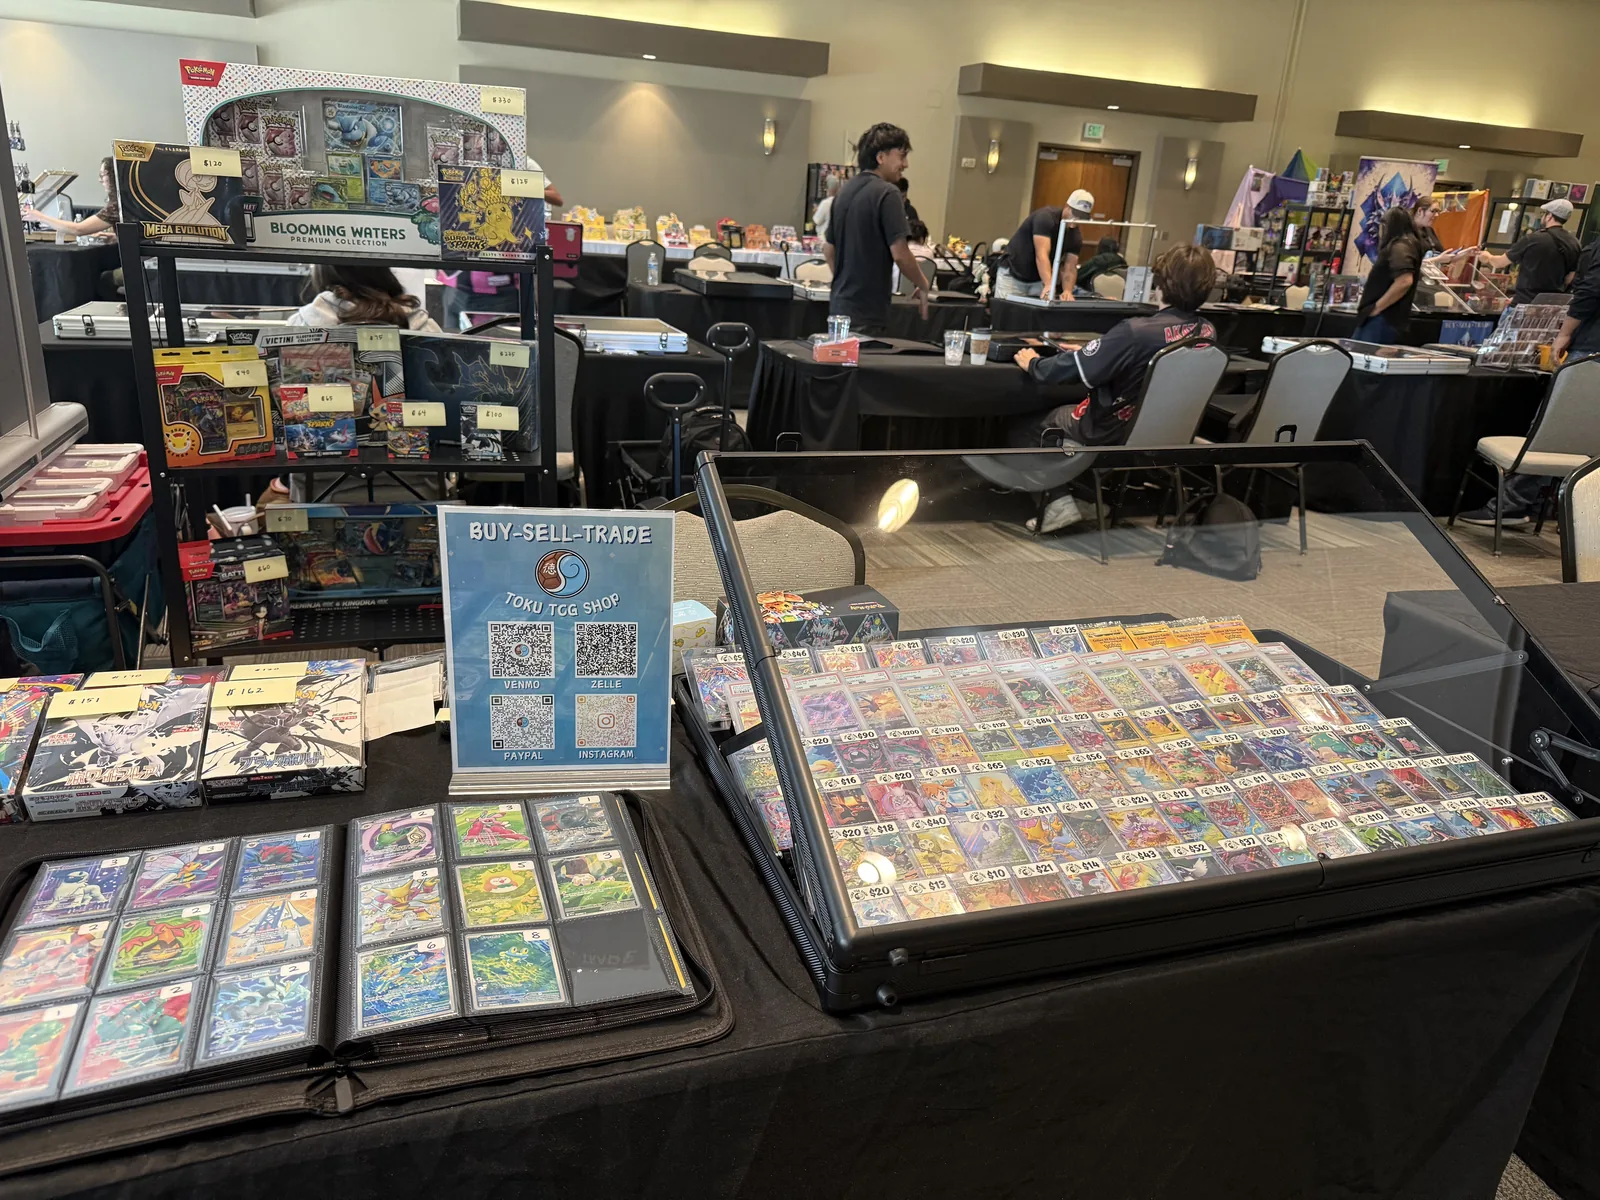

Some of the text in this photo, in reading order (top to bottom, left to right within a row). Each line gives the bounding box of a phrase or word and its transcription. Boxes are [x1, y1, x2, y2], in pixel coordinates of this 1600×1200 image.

[203, 159, 222, 167] $120
[145, 223, 227, 240] MEGA EVOLUTION
[270, 222, 406, 240] BLOOMING WATERS
[290, 236, 387, 247] PREMIUM COLLECTION
[450, 240, 486, 250] SPARKS
[265, 336, 294, 345] VICTINI
[469, 521, 652, 545] BUY-SELL-TRADE
[505, 591, 621, 617] TOKU TCG SHOP
[1011, 630, 1025, 638] $30
[1064, 626, 1077, 634] $35
[850, 644, 863, 652] $13
[791, 650, 807, 658] $46
[503, 680, 540, 690] VENMO
[591, 680, 622, 689] ZELLE
[1393, 719, 1407, 727] $10
[1270, 728, 1285, 736] $20
[1313, 724, 1329, 732] $40
[1356, 724, 1370, 732] $20
[857, 731, 875, 739] $90
[1224, 734, 1239, 742] $57
[812, 737, 829, 745] $20
[1177, 740, 1192, 748] $55
[503, 752, 543, 761] PAYPAL
[578, 750, 634, 760] INSTAGRAM
[1134, 748, 1151, 756] $65
[1086, 753, 1103, 761] $56
[1429, 757, 1444, 765] $12
[1460, 754, 1474, 762] $10
[987, 762, 1004, 770] $65
[1036, 758, 1052, 766] $52
[1366, 761, 1378, 769] $11
[1398, 758, 1412, 767] $16
[942, 767, 957, 775] $16
[1329, 764, 1343, 773] $11
[894, 772, 912, 780] $20
[1253, 775, 1268, 783] $11
[1291, 770, 1307, 779] $14
[841, 777, 857, 785] $16
[1215, 785, 1231, 793] $18
[1173, 790, 1190, 798] $12
[1532, 793, 1548, 803] $18
[1131, 796, 1148, 804] $24
[1460, 800, 1475, 809] $14
[1496, 797, 1511, 806] $16
[1037, 805, 1053, 814] $11
[1079, 801, 1093, 810] $11
[1414, 805, 1430, 815] $21
[986, 810, 1005, 819] $32
[1367, 812, 1383, 822] $10
[927, 818, 947, 826] $40
[1320, 820, 1338, 830] $20
[842, 829, 861, 837] $20
[877, 825, 894, 833] $18
[1238, 838, 1256, 847] $37
[1188, 844, 1207, 853] $52
[1137, 851, 1157, 860] $43
[1035, 863, 1054, 873] $21
[1082, 860, 1100, 871] $14
[987, 870, 1006, 880] $10
[928, 880, 947, 891] $13
[869, 886, 890, 897] $20
